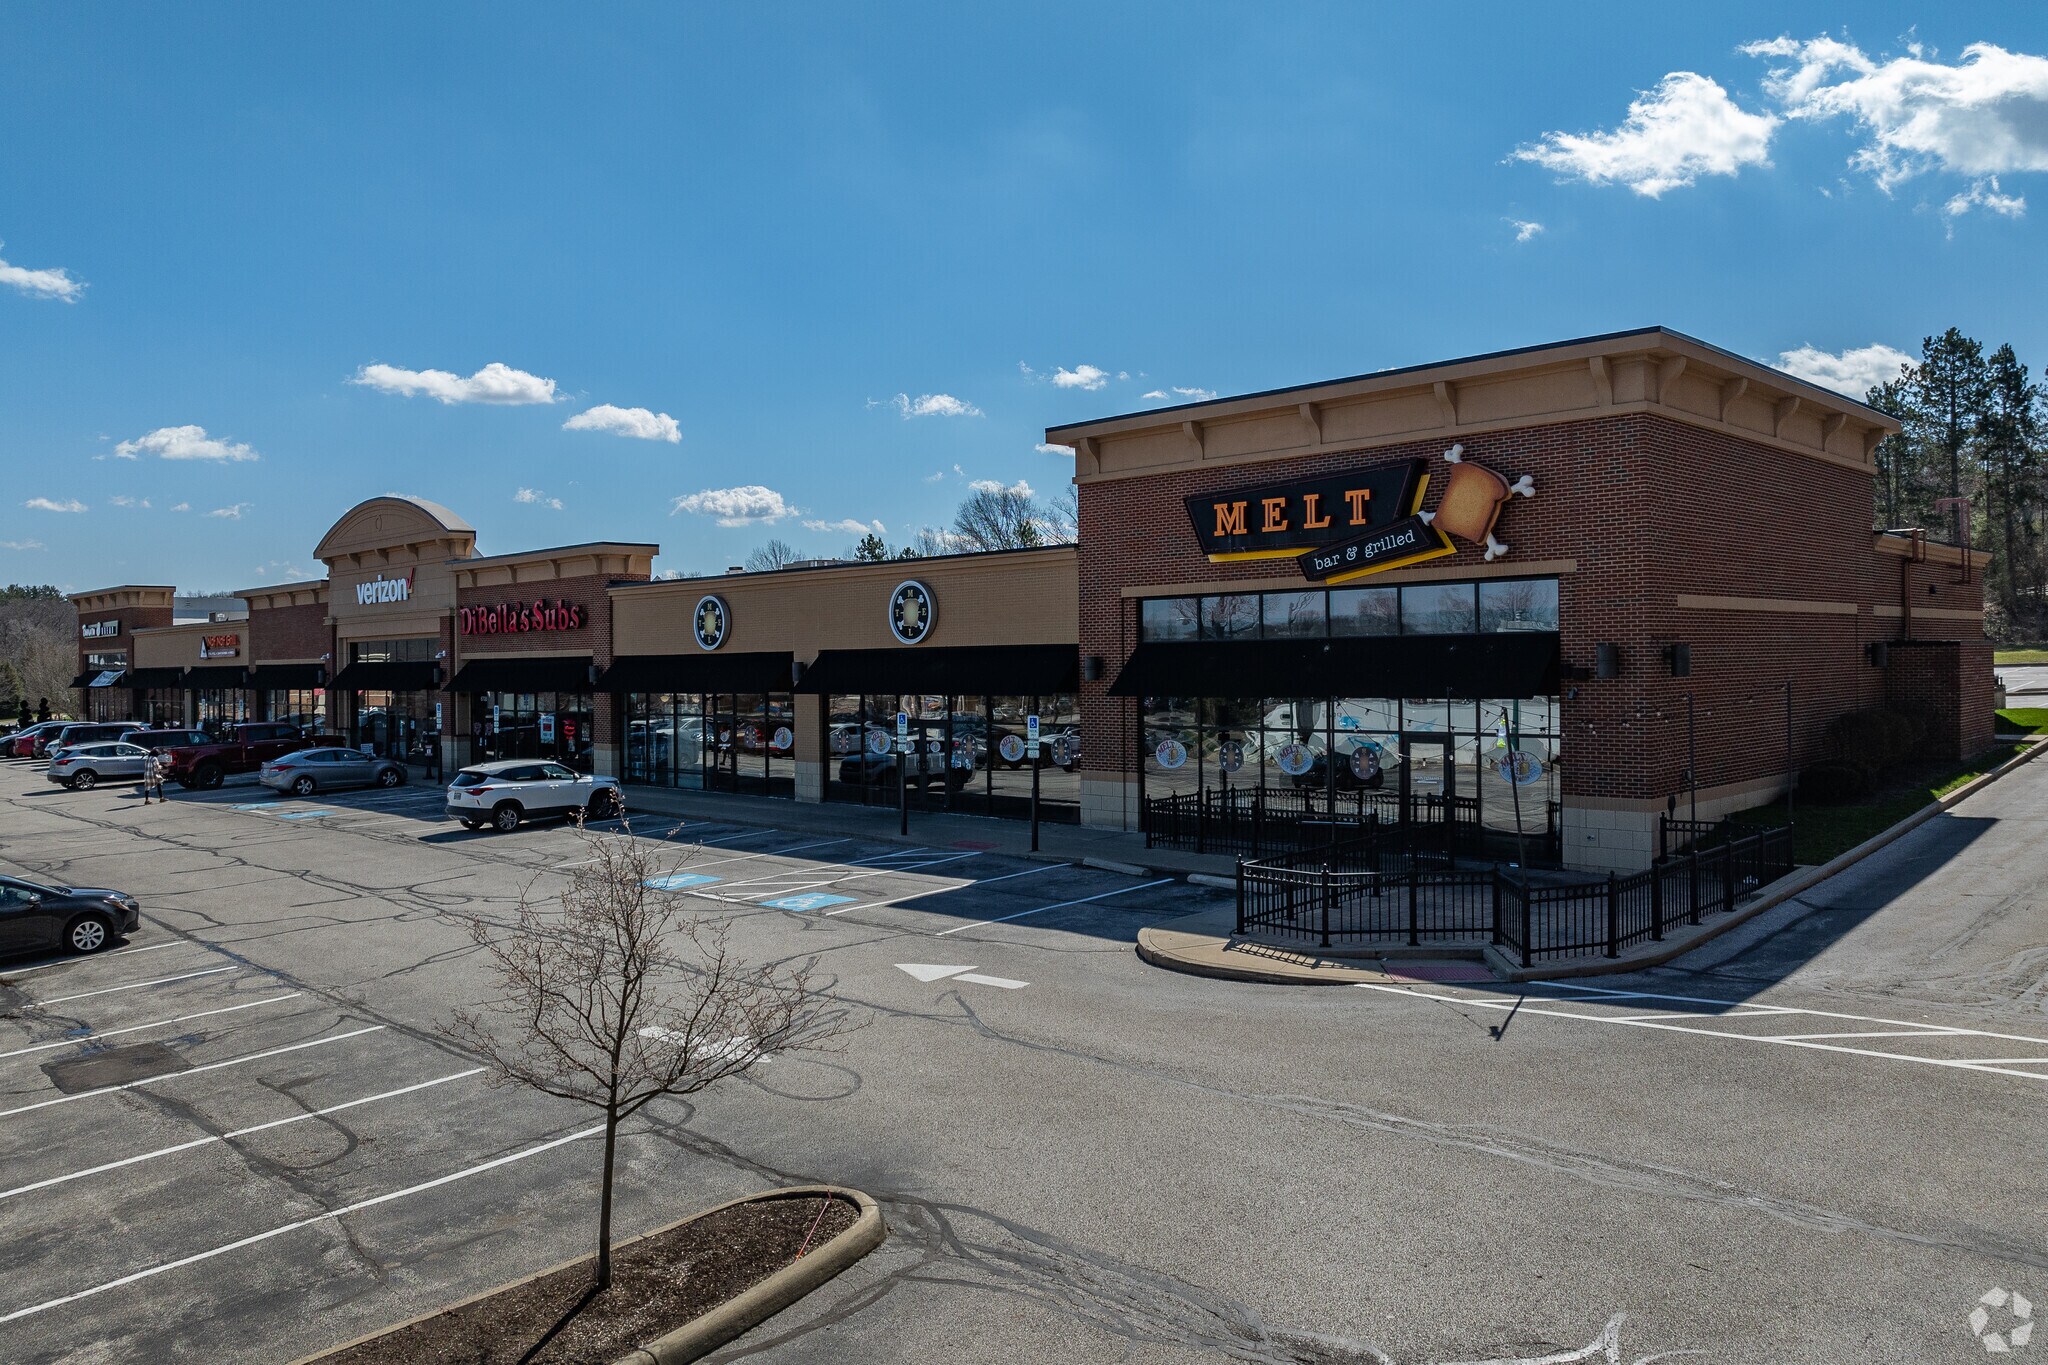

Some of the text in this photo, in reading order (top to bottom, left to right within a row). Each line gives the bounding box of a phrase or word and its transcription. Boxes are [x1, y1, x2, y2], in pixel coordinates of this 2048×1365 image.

[1214, 489, 1370, 537] MELT
[1314, 529, 1415, 570] bar & grilled
[356, 574, 408, 605] verizon
[459, 600, 580, 635] DiBella's Subs
